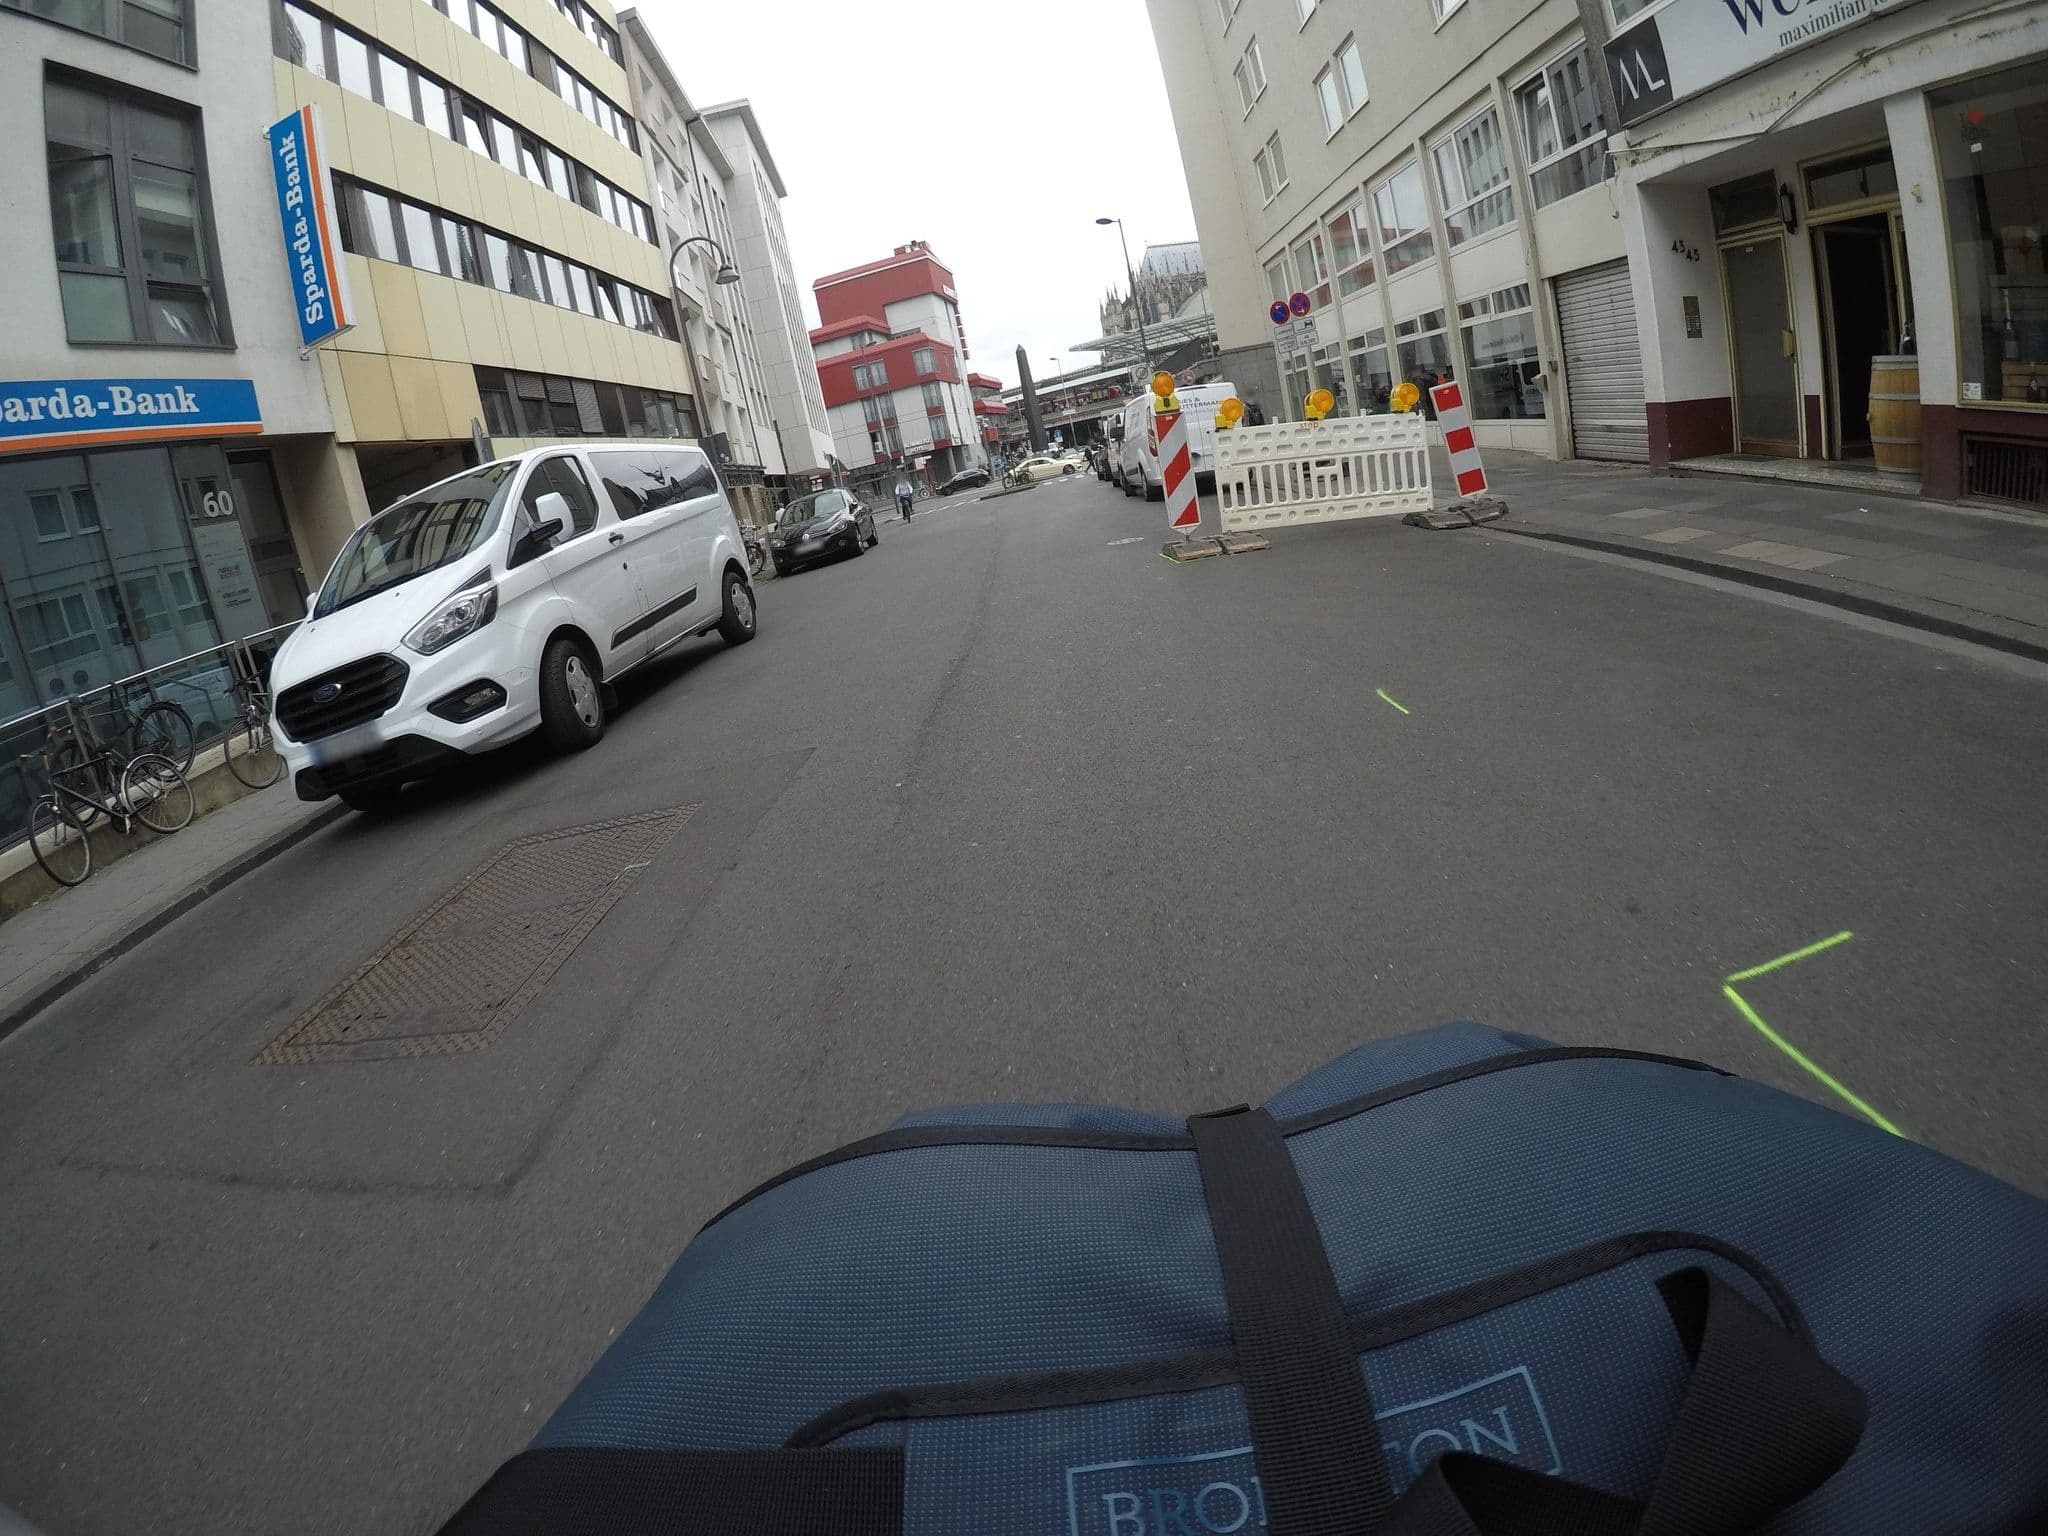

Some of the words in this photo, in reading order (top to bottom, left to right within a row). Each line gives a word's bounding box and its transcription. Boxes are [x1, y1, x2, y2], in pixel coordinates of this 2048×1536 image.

[1779, 0, 1867, 47] maximilian
[280, 131, 325, 325] Sparda-Bank
[0, 386, 200, 424] arda-Bank
[203, 490, 234, 518] 60
